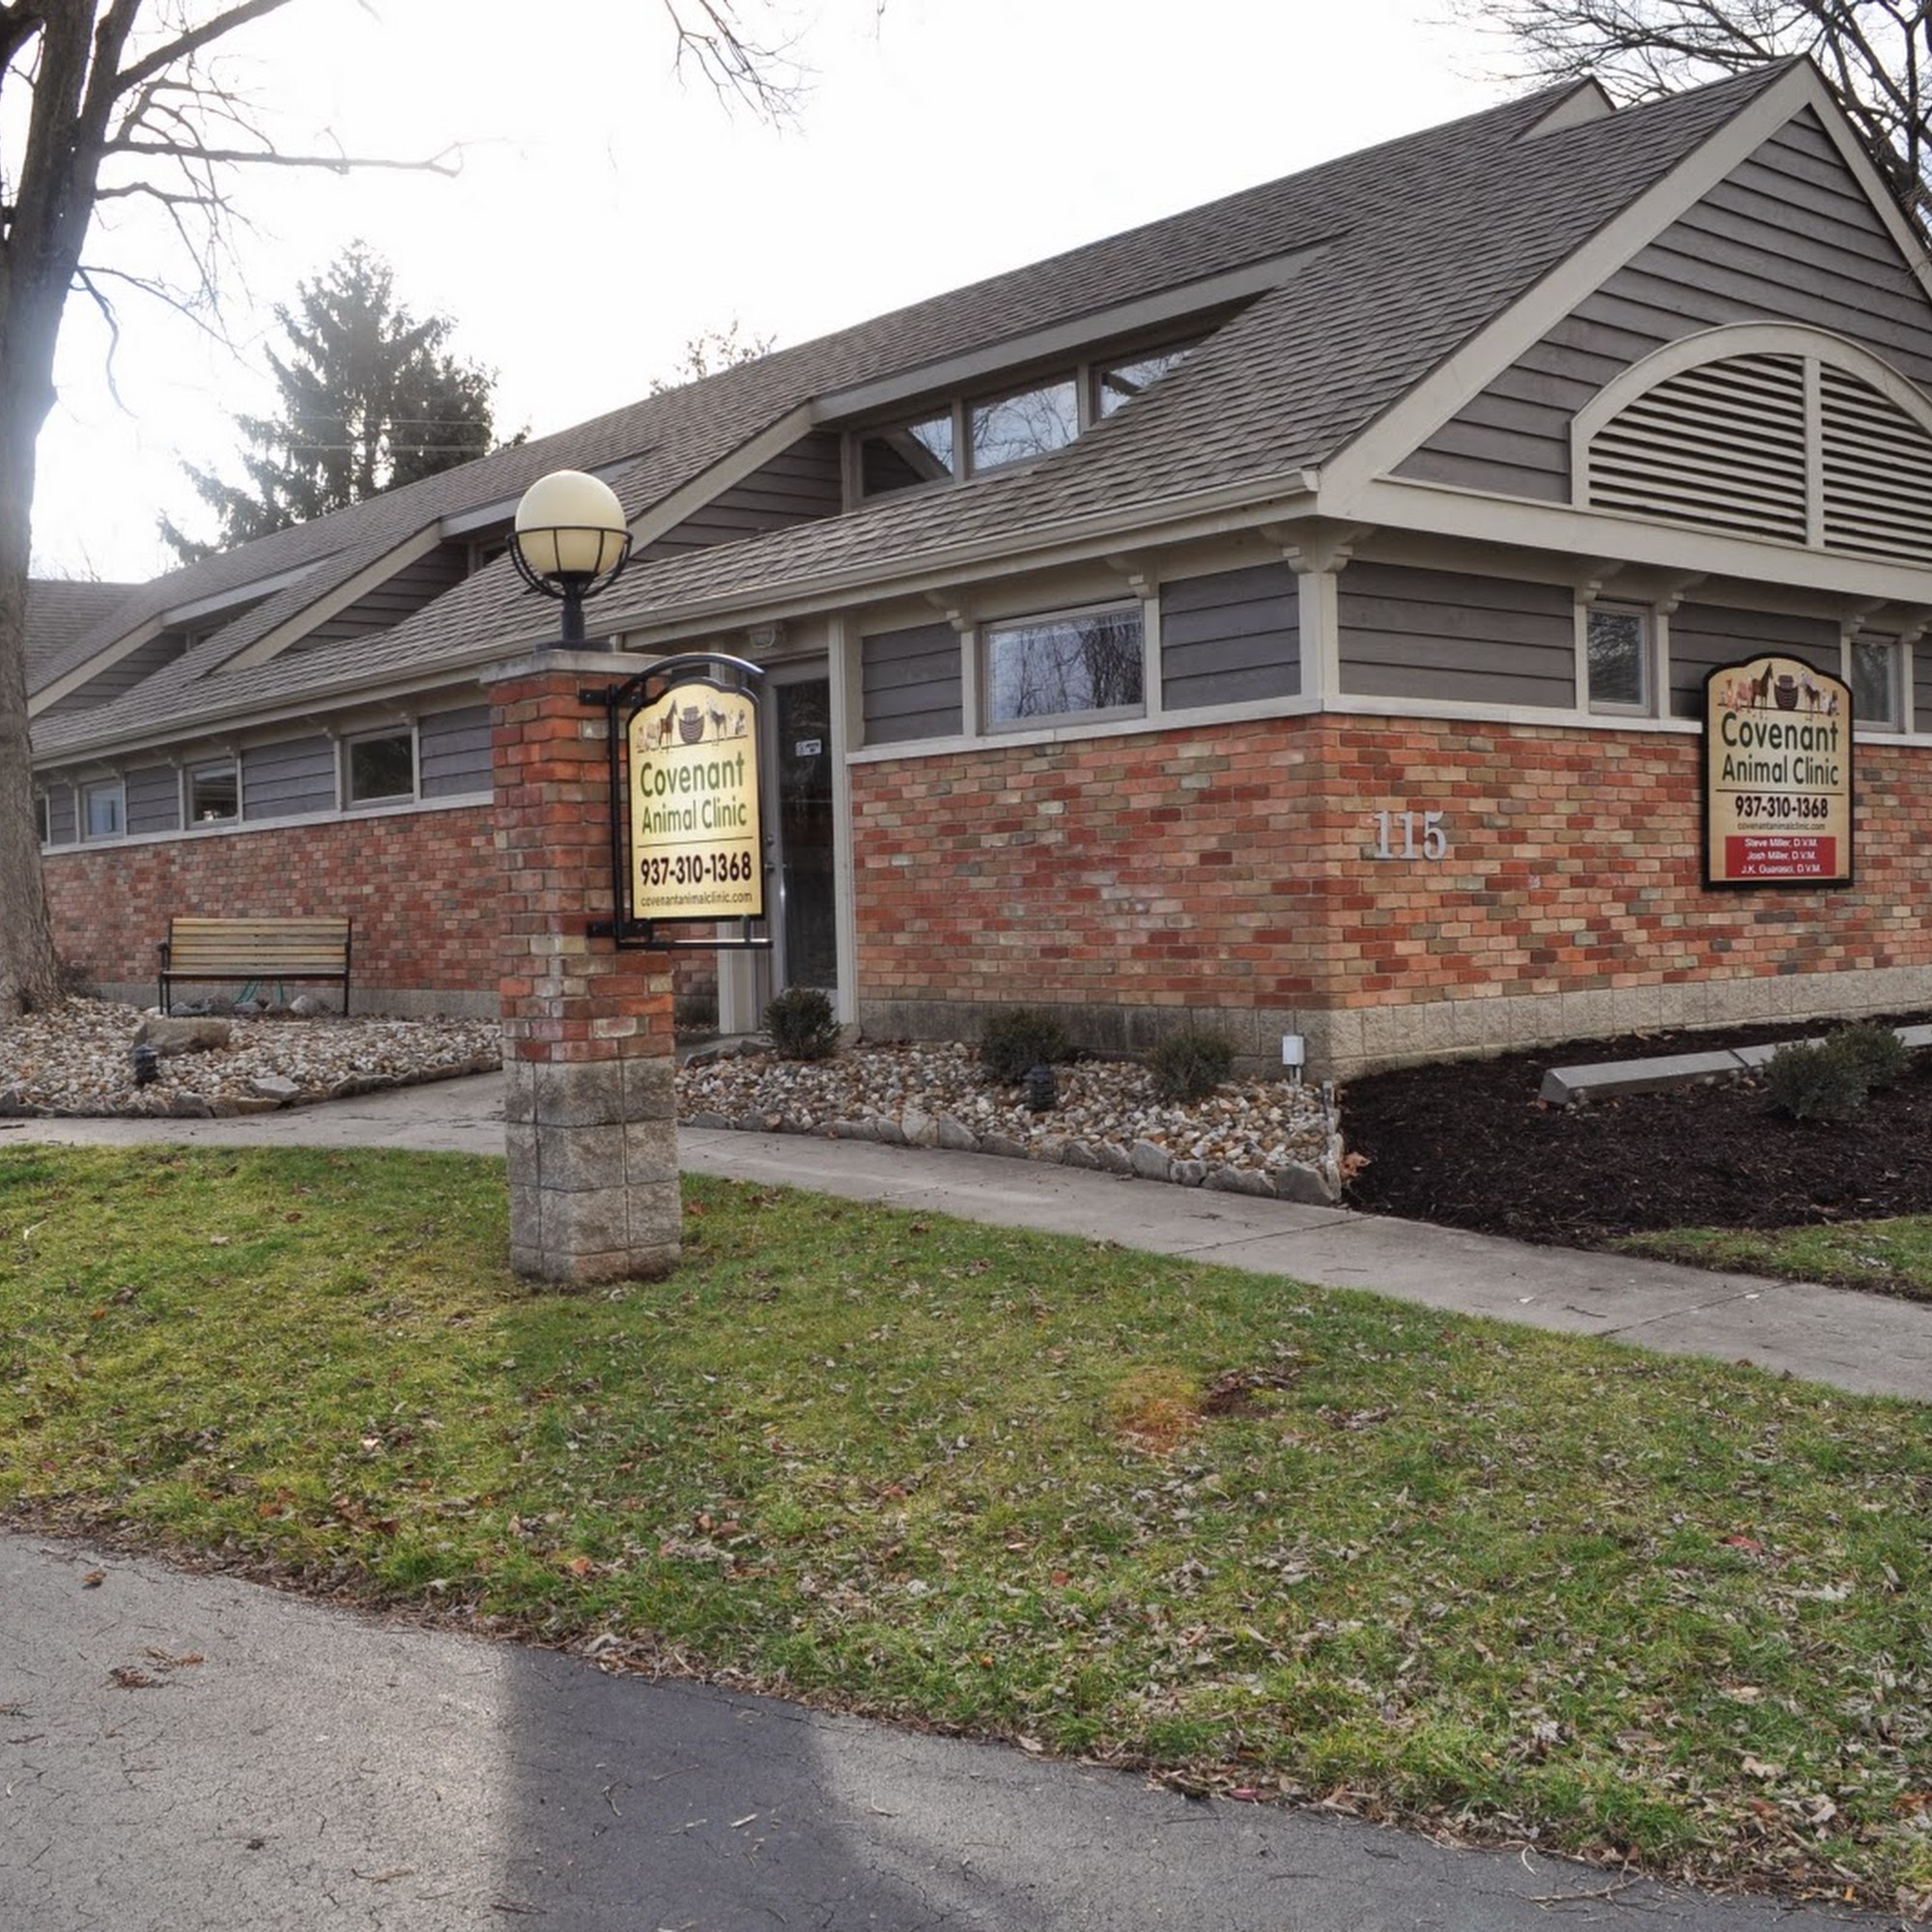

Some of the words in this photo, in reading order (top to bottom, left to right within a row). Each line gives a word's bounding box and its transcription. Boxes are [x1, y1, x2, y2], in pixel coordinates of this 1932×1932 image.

[1721, 711, 1838, 752] Covenant
[640, 751, 745, 798] Covenant
[1722, 753, 1787, 783] Animal
[1793, 755, 1838, 785] Clinic
[642, 800, 697, 835] Animal
[702, 795, 747, 830] Clinic
[1735, 795, 1828, 818] 937-310-1368
[1374, 810, 1446, 860] 115
[1737, 822, 1826, 831] covenantanimalclinic.com
[1745, 838, 1767, 847] Steve
[640, 851, 752, 886] 937-310-1368
[1747, 851, 1766, 861] Josh
[640, 892, 753, 907] covenantanimalclinic.com
